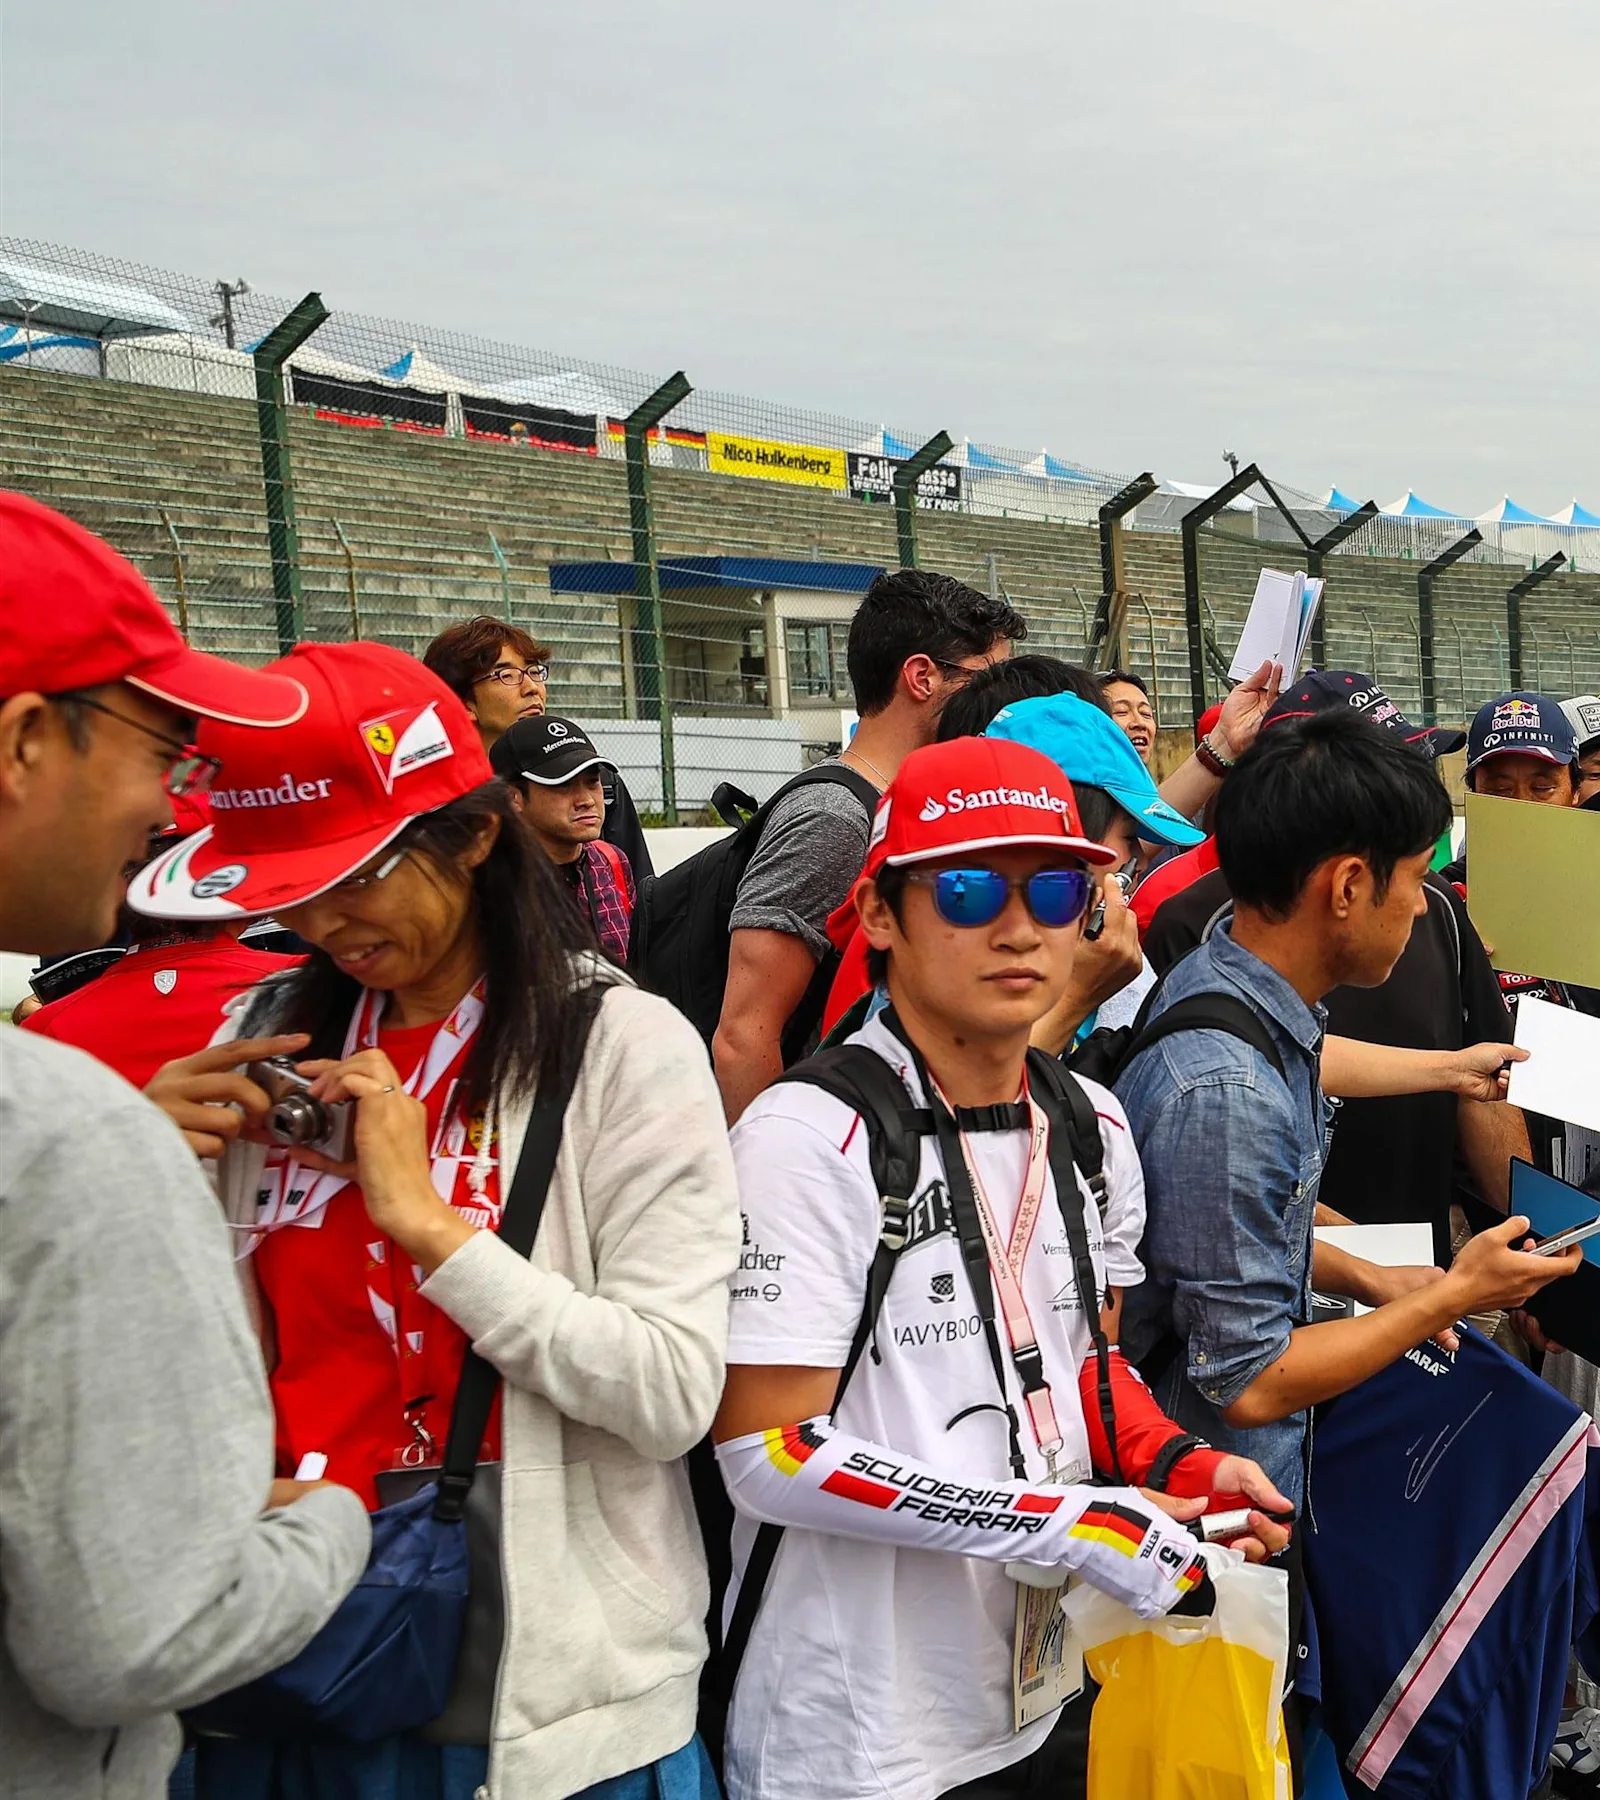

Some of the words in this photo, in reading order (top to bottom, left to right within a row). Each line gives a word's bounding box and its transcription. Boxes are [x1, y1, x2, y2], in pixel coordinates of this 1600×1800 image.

[723, 443, 753, 463] Nico
[755, 448, 832, 474] Hulkenberg
[1491, 717, 1515, 731] Red
[1516, 715, 1541, 729] Bull
[1503, 731, 1554, 744] INFINITI
[207, 773, 332, 810] antander
[946, 785, 1069, 814] Santander
[894, 1315, 982, 1347] AVYBOO
[841, 1452, 1013, 1510] SCUDERIA
[893, 1498, 1050, 1534] FERRARI
[1140, 1529, 1162, 1559] VETTEL
[1158, 1545, 1185, 1569] 5
